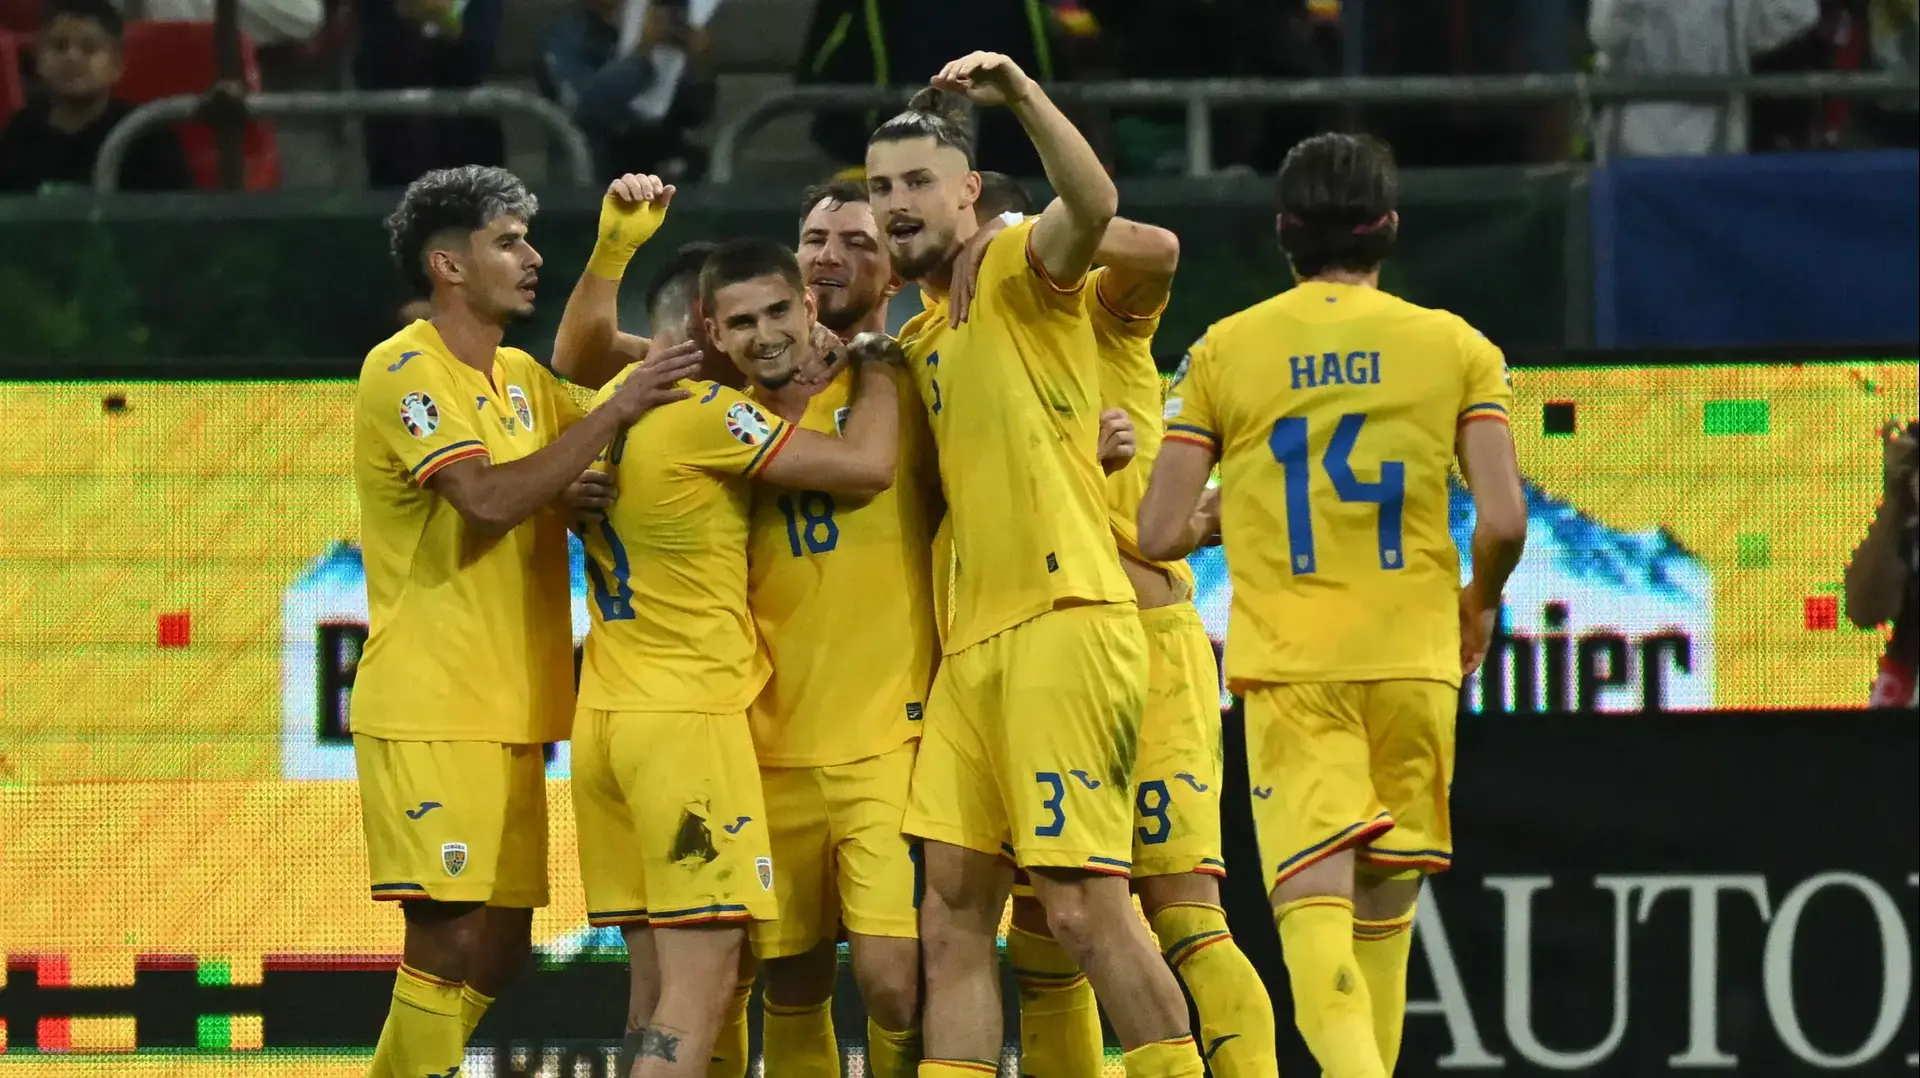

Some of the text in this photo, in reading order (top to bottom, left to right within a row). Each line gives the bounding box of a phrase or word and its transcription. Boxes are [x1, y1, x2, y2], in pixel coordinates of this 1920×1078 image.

[1289, 351, 1381, 390] HAGI
[778, 489, 839, 558] 18
[1268, 413, 1405, 576] 14
[1035, 772, 1066, 837] 3
[1406, 870, 1918, 1071] AUTO
